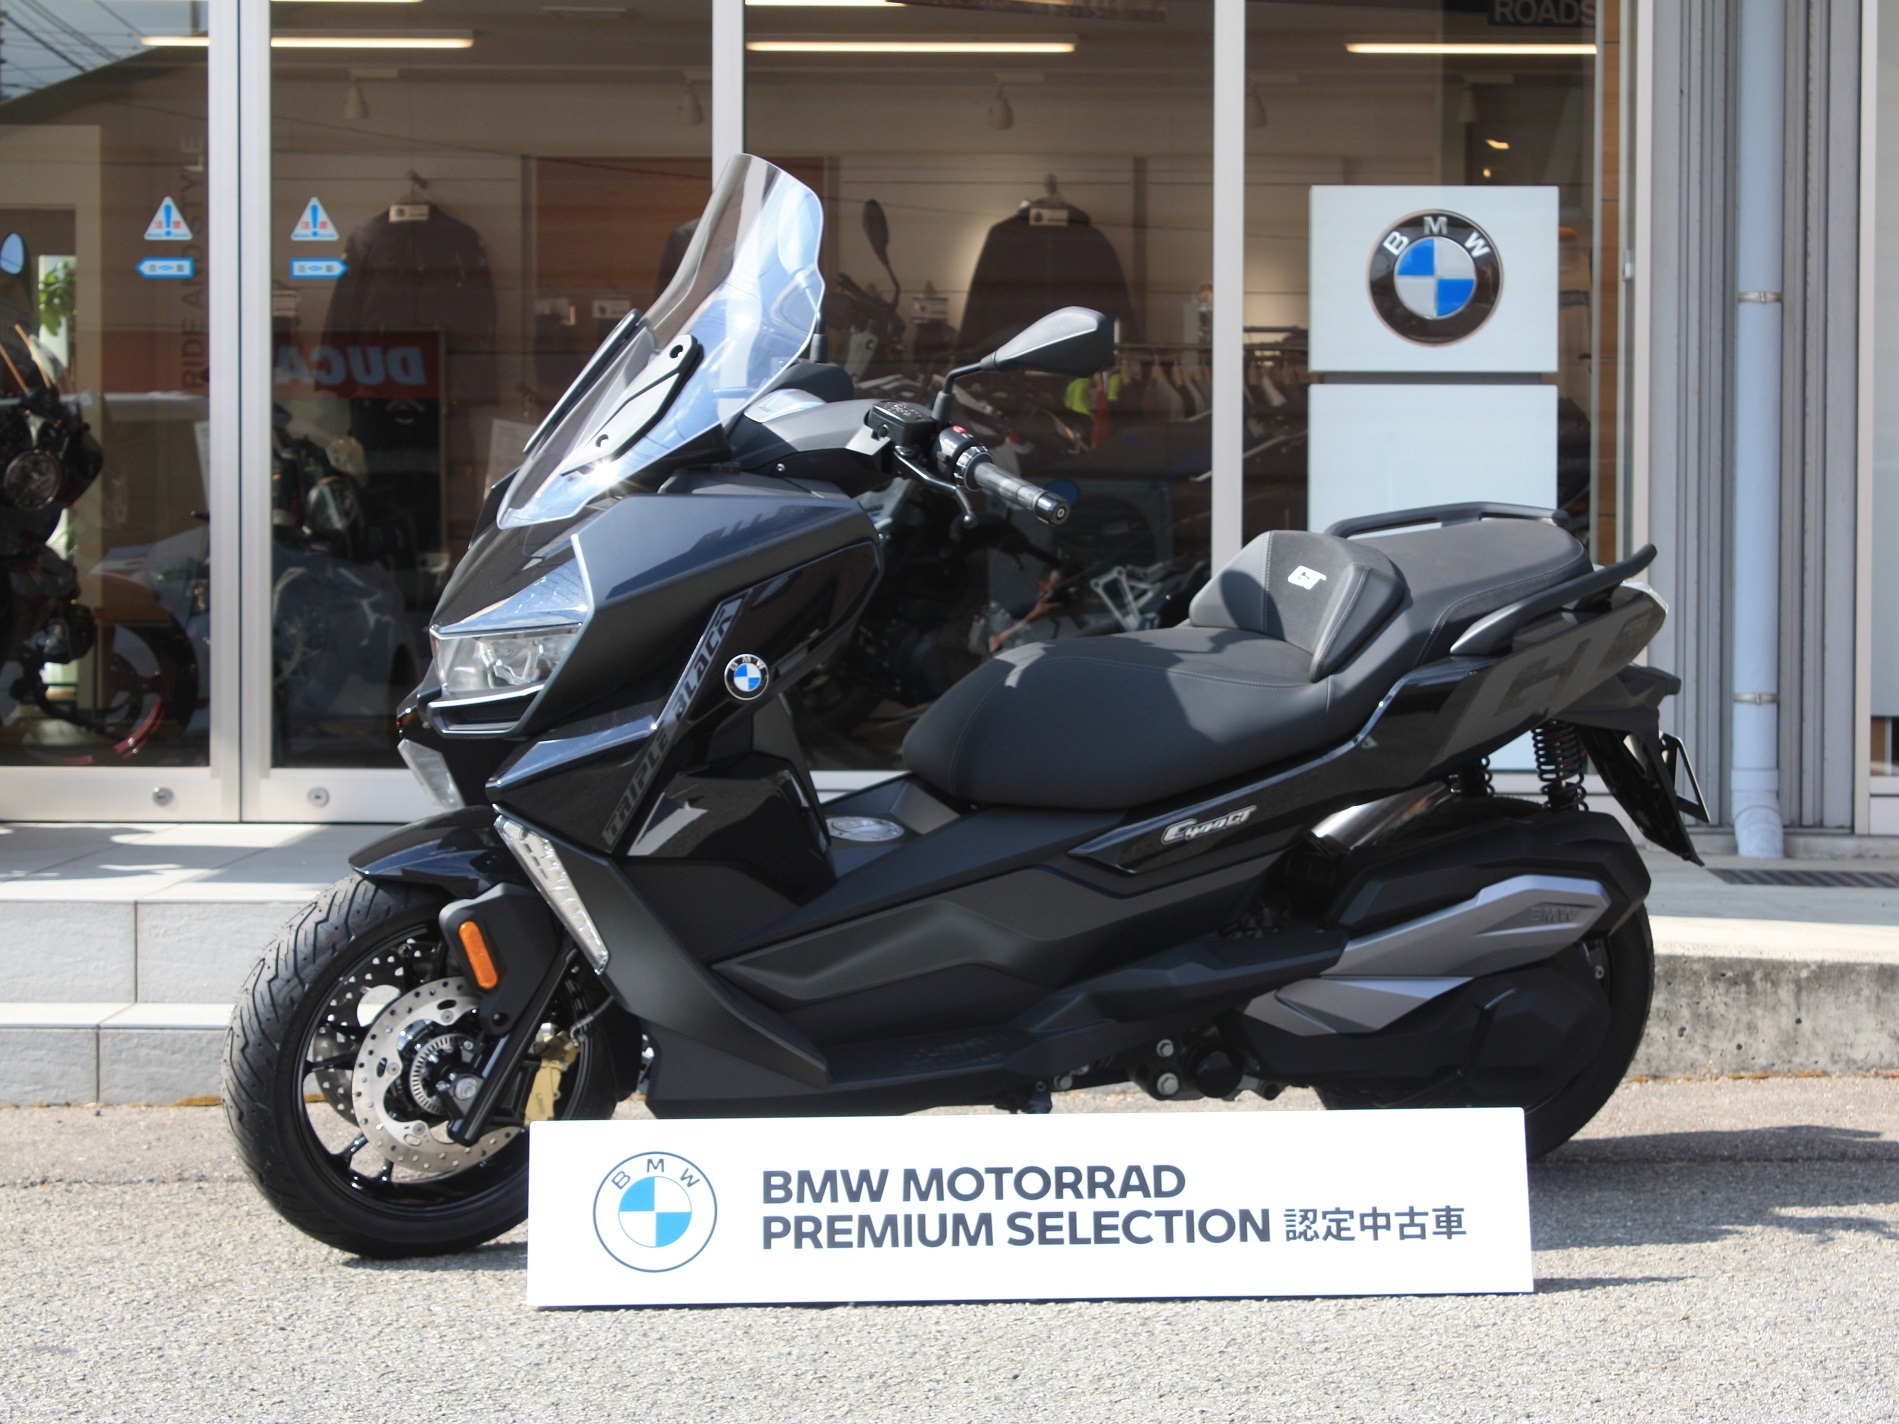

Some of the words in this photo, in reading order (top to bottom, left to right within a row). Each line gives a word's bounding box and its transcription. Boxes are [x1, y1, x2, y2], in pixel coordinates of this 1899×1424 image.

[1381, 215, 1491, 257] BMW
[672, 609, 734, 722] BLACK
[729, 655, 766, 671] BMW
[1529, 906, 1577, 923] BMW
[611, 1158, 700, 1190] BMW
[762, 1168, 889, 1204] BMW
[902, 1164, 1186, 1202] MOTORRAD
[762, 1212, 994, 1249] PREMIUM
[1007, 1208, 1270, 1246] SELECTION
[1283, 1205, 1467, 1242] 認定中古車
